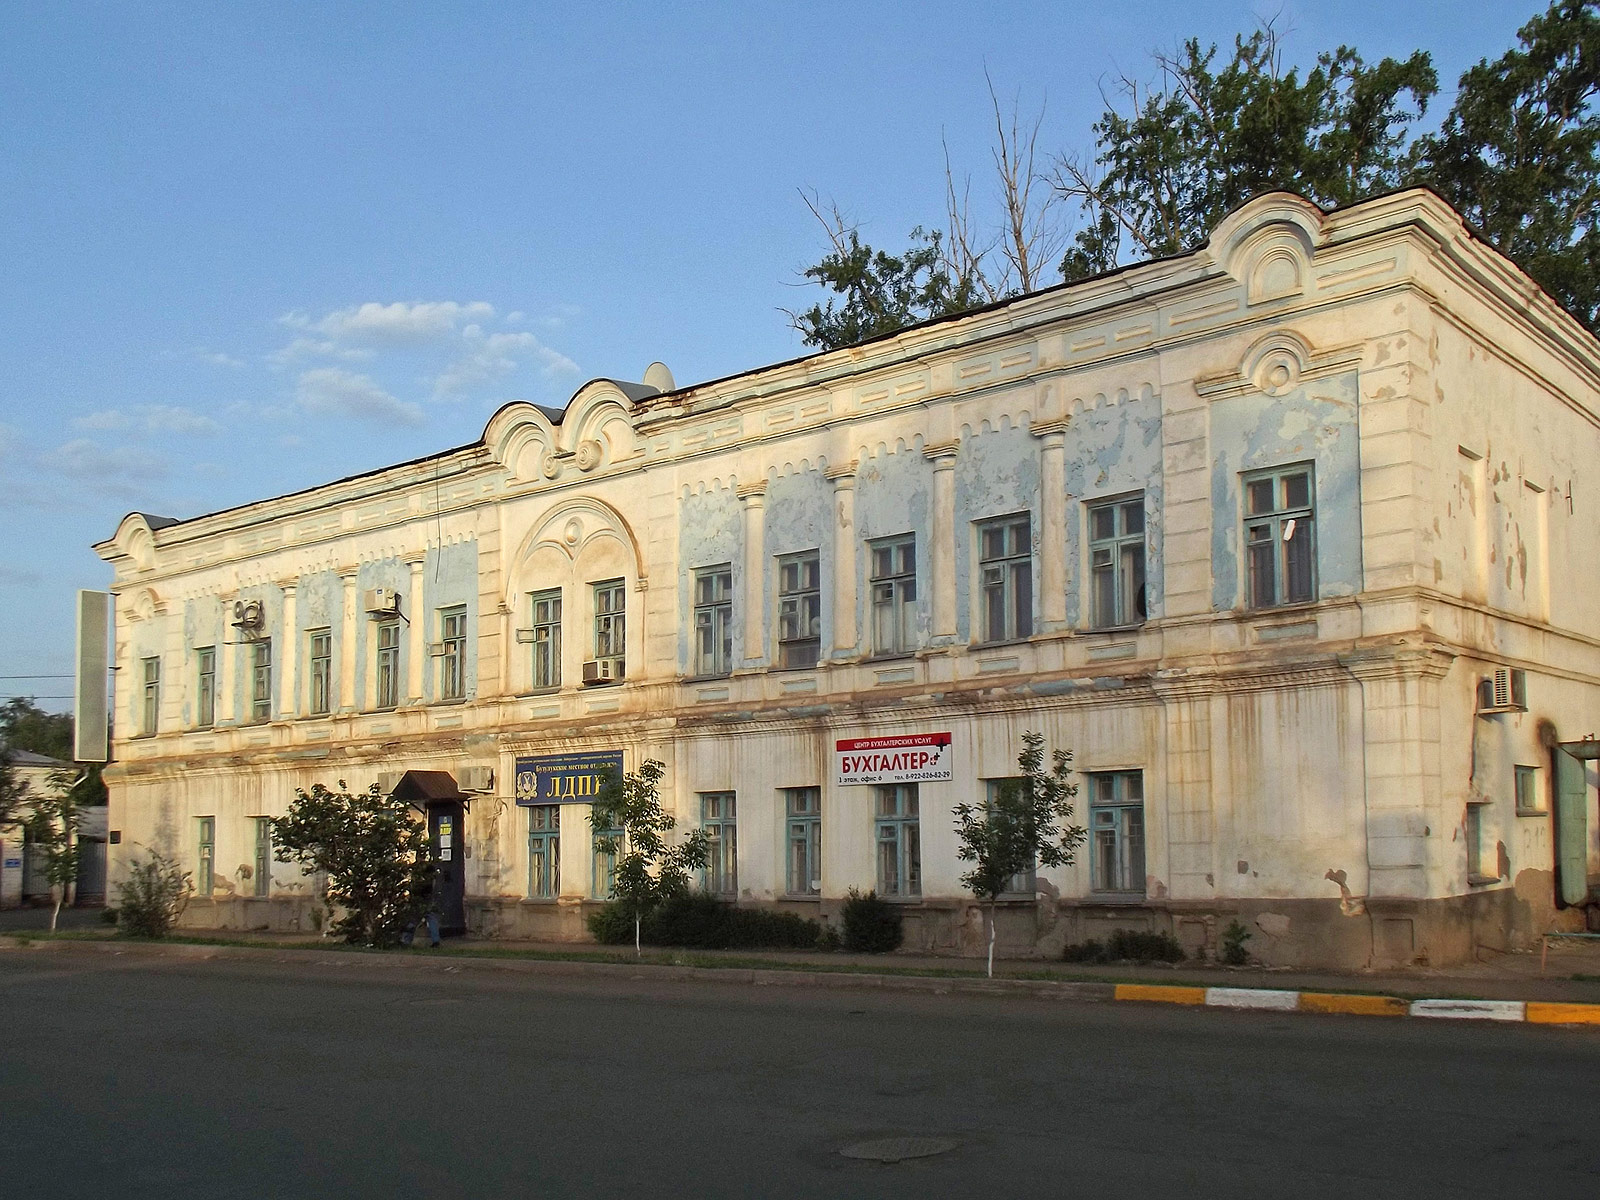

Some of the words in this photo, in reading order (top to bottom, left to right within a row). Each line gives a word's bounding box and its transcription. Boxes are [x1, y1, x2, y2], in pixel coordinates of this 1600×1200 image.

[854, 741, 870, 749] ЦЕНТР
[870, 739, 914, 748] БУХГАЛТЕРСКИХ
[842, 752, 929, 773] БУХГАЛТЕР
